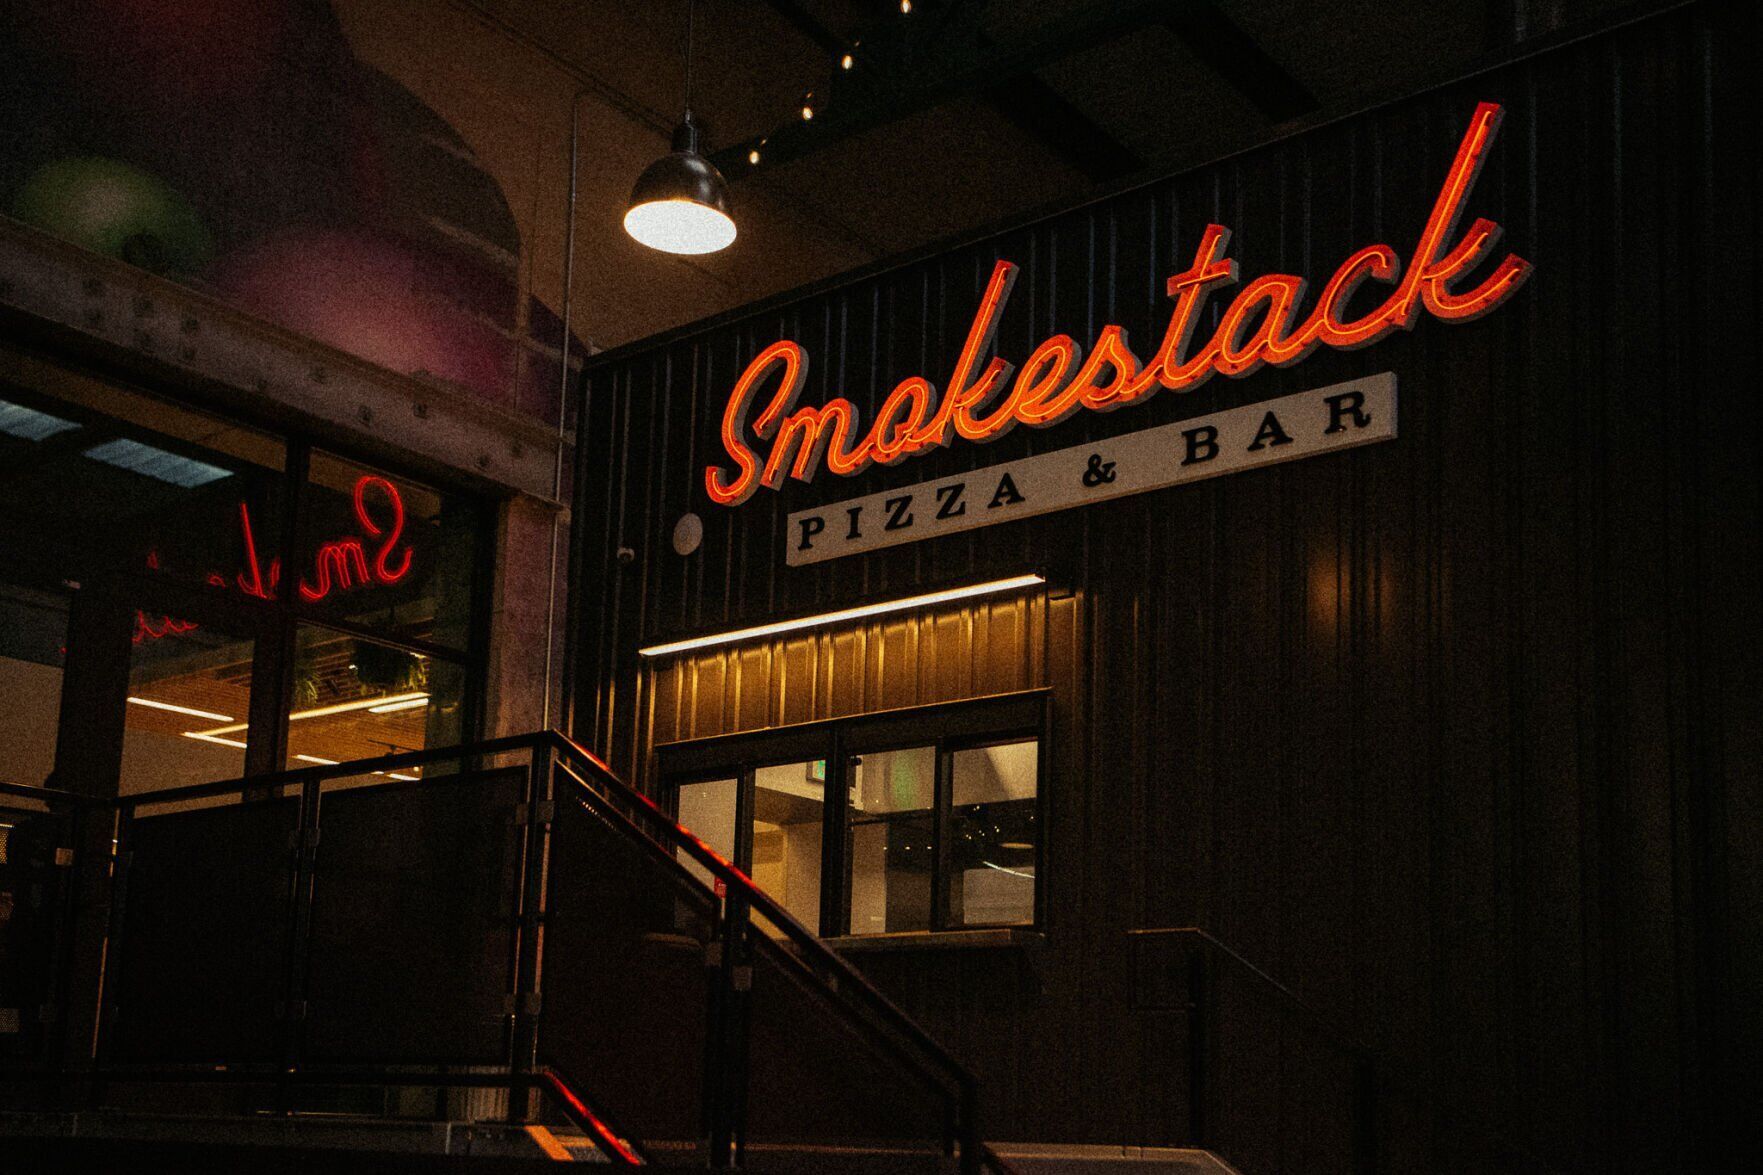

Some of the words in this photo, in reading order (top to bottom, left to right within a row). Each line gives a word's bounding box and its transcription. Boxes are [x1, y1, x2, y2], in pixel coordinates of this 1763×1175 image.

[705, 102, 1533, 505] Smokestack
[797, 472, 1026, 551] PIZZA
[1081, 454, 1117, 487] &
[1181, 390, 1371, 466] BAR
